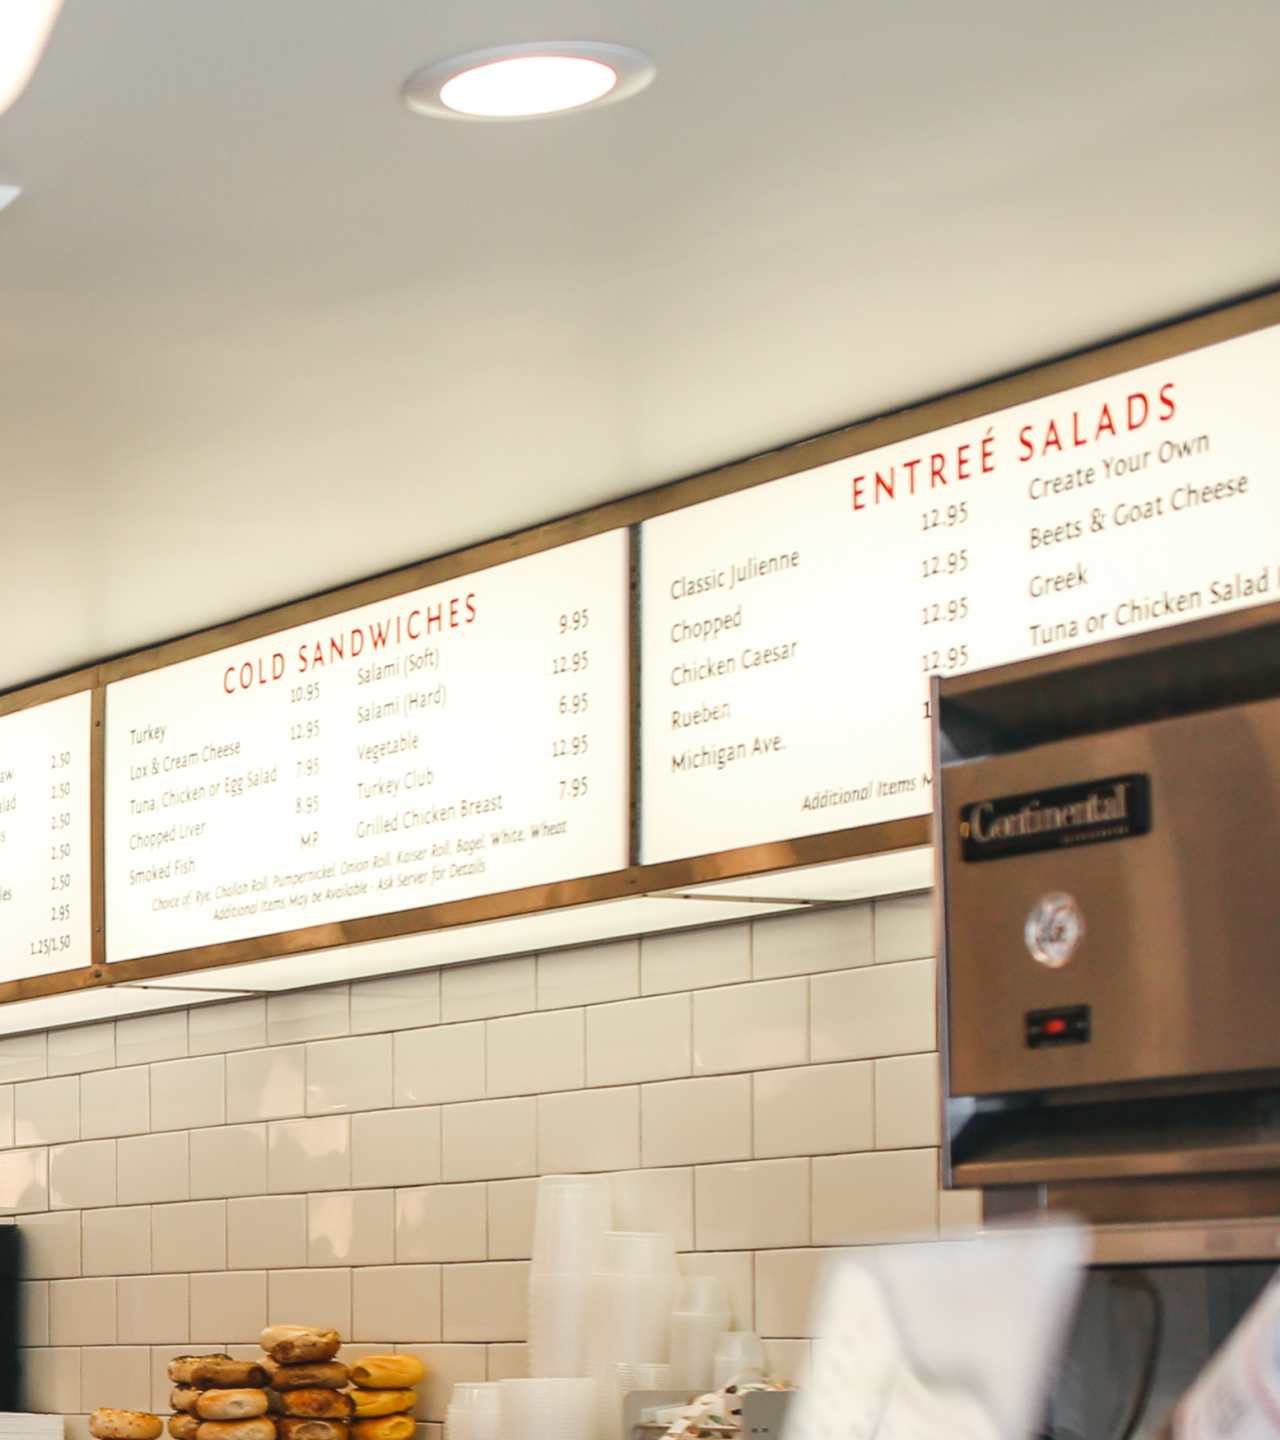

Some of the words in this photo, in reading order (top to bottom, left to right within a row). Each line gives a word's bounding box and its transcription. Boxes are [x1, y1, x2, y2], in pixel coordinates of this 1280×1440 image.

[852, 427, 994, 511] ENTREÉ
[1019, 383, 1175, 462] SALADS
[1028, 467, 1095, 500] Create
[1101, 450, 1151, 478] Your
[1157, 434, 1208, 464] Own
[922, 501, 967, 531] 12.95
[1030, 520, 1082, 549] Beets
[1090, 507, 1104, 532] &
[1113, 496, 1163, 526] Goat
[1170, 475, 1248, 511] Cheese
[670, 571, 724, 600] Classic
[729, 551, 799, 588] Julienne
[922, 548, 968, 578] 12.95
[1029, 562, 1087, 598] Greek
[922, 596, 968, 625] 12.95
[1028, 620, 1077, 645] Tuna
[1085, 613, 1108, 634] or
[1114, 591, 1200, 626] Chicken
[1209, 566, 1268, 604] Salad
[559, 608, 588, 634] 9.95
[671, 606, 741, 643] Chopped
[223, 652, 284, 694] COLD
[298, 593, 476, 672] SANDWICHES
[922, 644, 968, 672] 12.95
[357, 663, 399, 685] Salami
[404, 647, 438, 676] (Soft)
[553, 650, 588, 674] 12.95
[671, 657, 735, 686] Chicken
[741, 641, 798, 669] Caesar
[291, 681, 320, 703] 10.95
[357, 701, 399, 723] Salami
[404, 686, 445, 714] (Hard)
[559, 692, 588, 714] 6.95
[290, 719, 319, 740] 12.95
[671, 703, 730, 728] Rueben
[129, 724, 165, 744] Turkey
[359, 735, 418, 763] Vegetable
[552, 734, 587, 757] 12.95
[129, 766, 147, 781] Lox
[151, 757, 159, 775] &
[162, 752, 199, 772] Cream
[201, 741, 240, 762] Cheese
[296, 756, 320, 776] 7.95
[671, 743, 745, 772] Michigan
[751, 735, 785, 753] Ave.
[161, 786, 205, 807] Chicken
[208, 782, 221, 797] or
[224, 776, 243, 797] Egg
[247, 767, 276, 788] Salad
[356, 780, 399, 799] Turkey
[403, 769, 432, 790] Club
[559, 776, 587, 798] 7.95
[800, 782, 872, 811] Additional
[877, 777, 916, 796] Items
[295, 794, 319, 814] 8.95
[356, 814, 398, 838] Grilled
[402, 805, 455, 829] Chicken
[460, 794, 502, 818] Breast
[129, 824, 175, 850] Chopped
[179, 821, 206, 839] Liver
[300, 831, 319, 847] MP
[129, 864, 170, 885] Smoked
[174, 857, 194, 874] Fish
[212, 899, 258, 920] Additional
[260, 898, 286, 912] Items
[287, 894, 309, 906] May
[311, 891, 322, 903] be
[324, 882, 368, 900] Available
[375, 877, 394, 890] Ask
[397, 872, 428, 887] Server
[431, 864, 446, 880] for
[448, 858, 485, 878] Details
